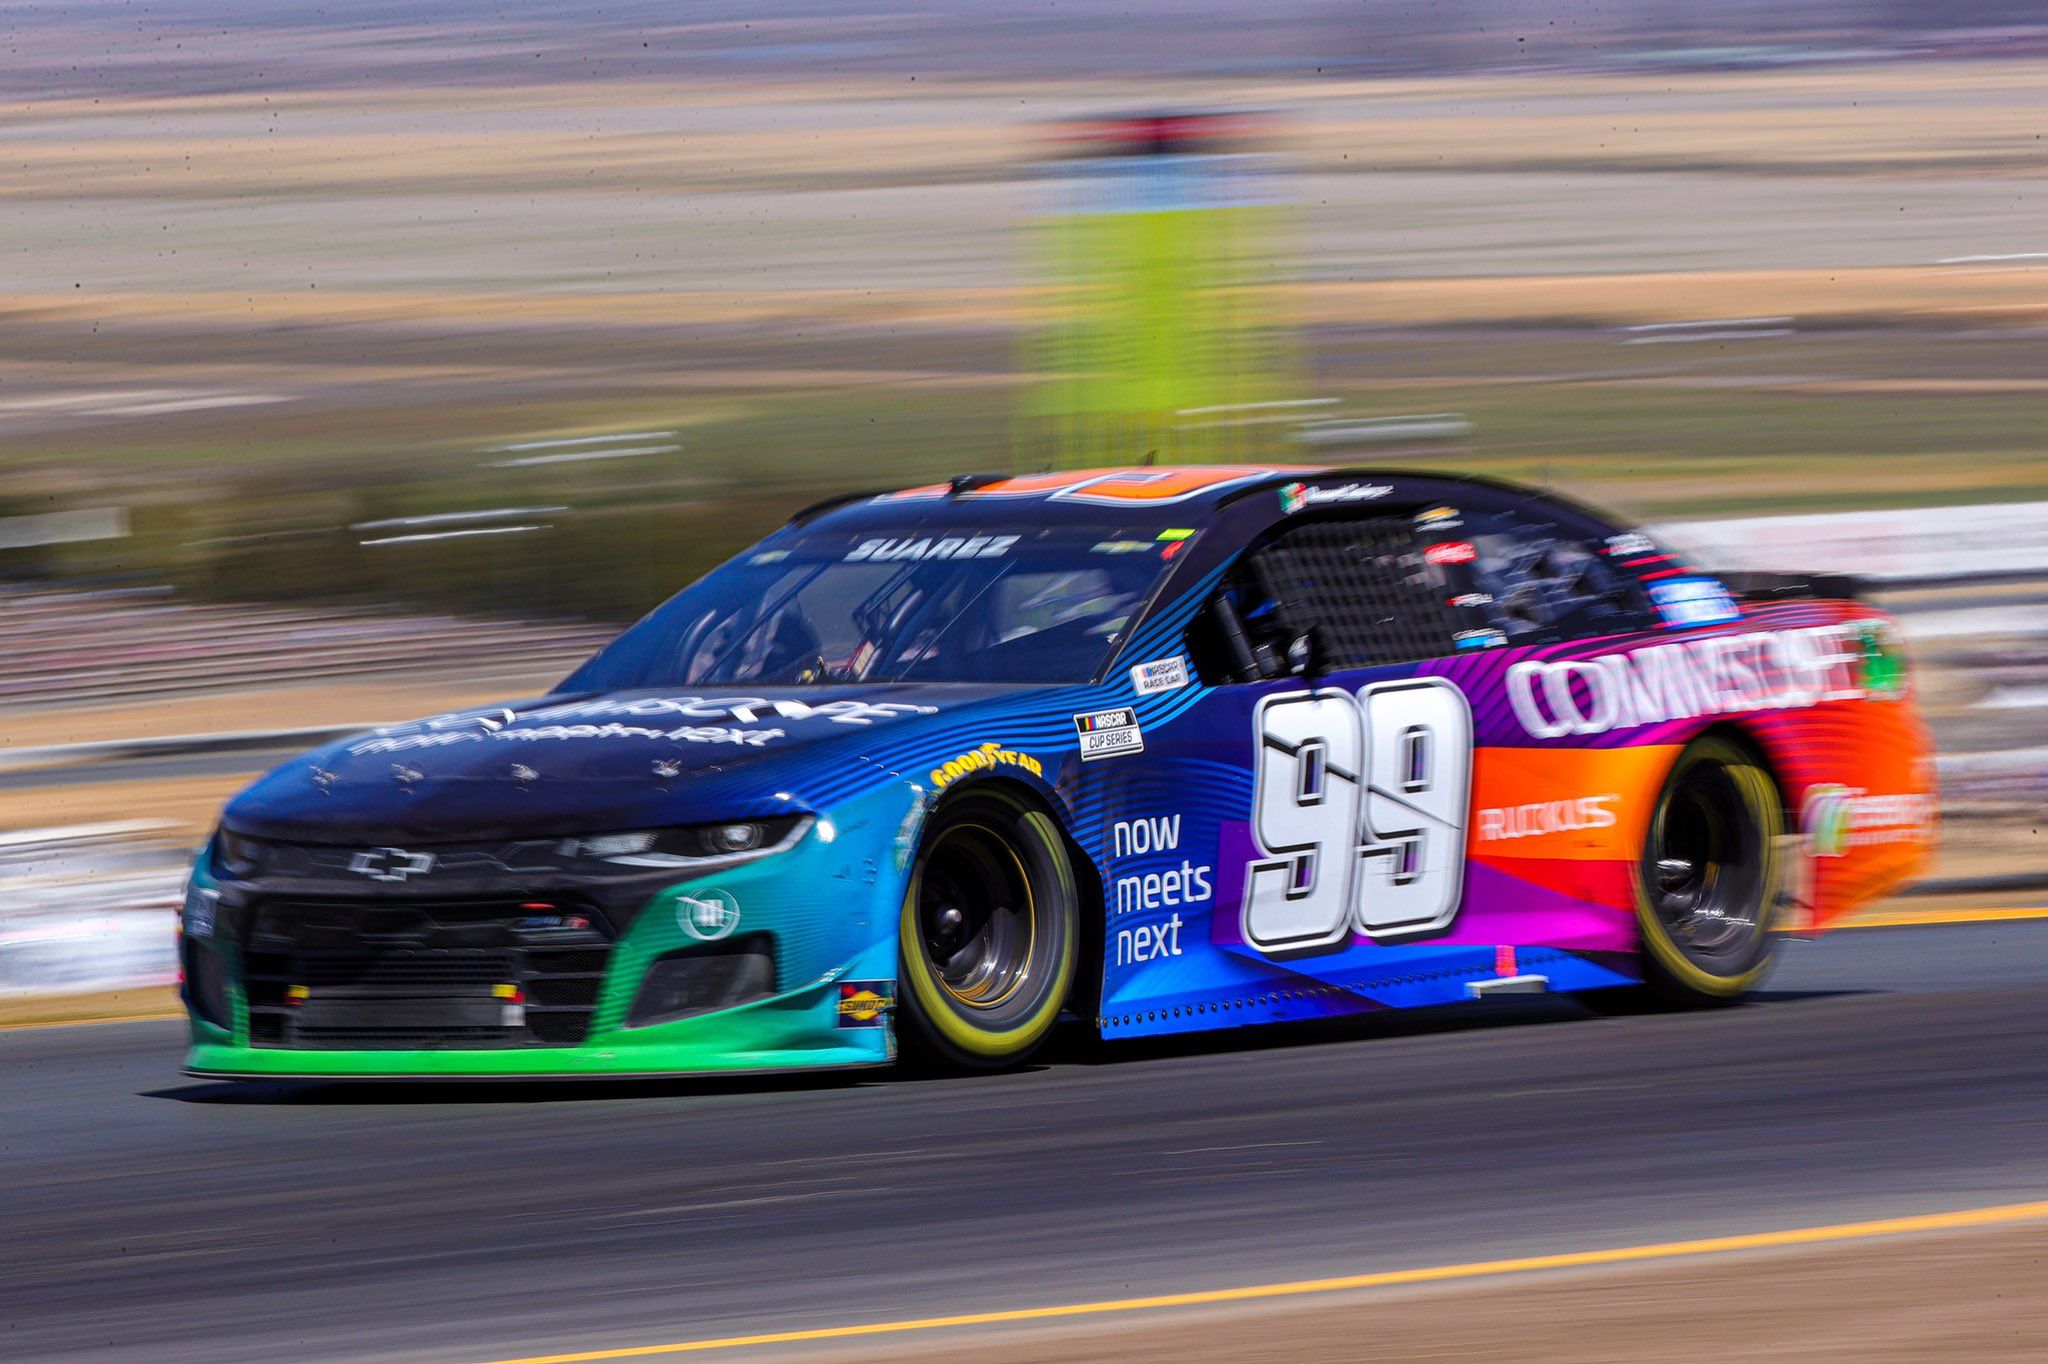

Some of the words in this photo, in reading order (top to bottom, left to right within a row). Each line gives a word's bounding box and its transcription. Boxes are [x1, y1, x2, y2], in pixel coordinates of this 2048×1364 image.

[842, 534, 1022, 562] SUAREZ
[1143, 677, 1165, 689] RACE
[1165, 673, 1182, 685] CAR
[1148, 660, 1179, 676] NASCAR
[1095, 712, 1128, 729] NASCAR
[1089, 734, 1105, 749] CUP
[1105, 730, 1133, 746] SERIES
[930, 742, 1043, 788] GOODYEAR
[1240, 675, 1474, 956] 99
[1114, 814, 1181, 858] now
[1117, 860, 1212, 914] meets
[1117, 913, 1183, 966] next
